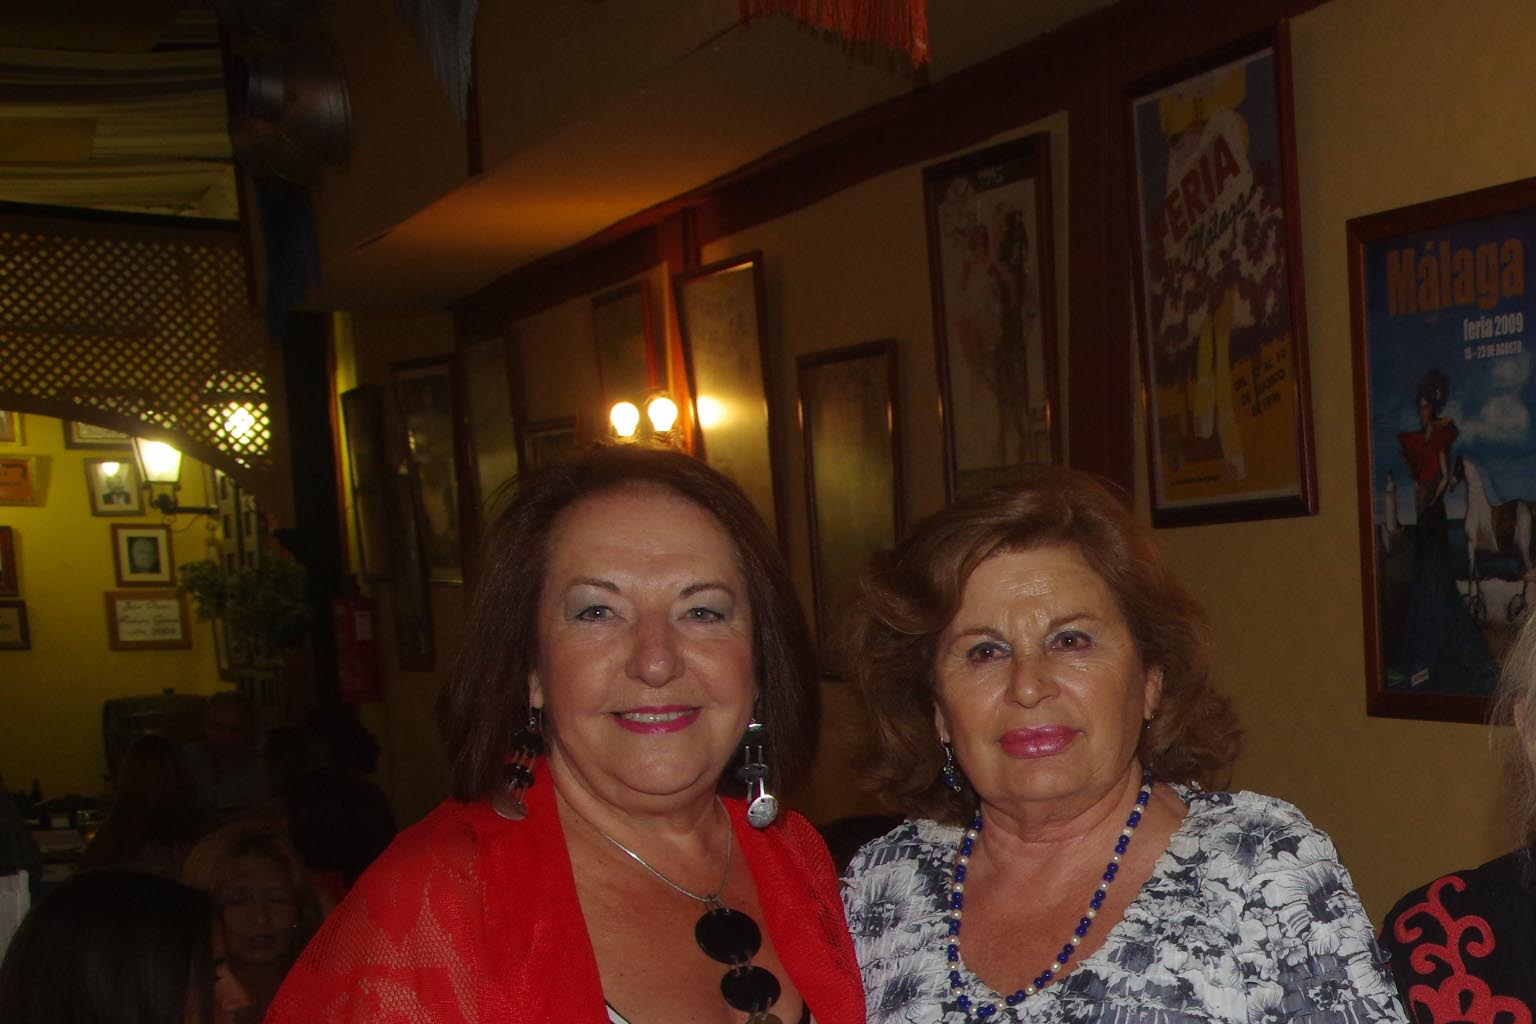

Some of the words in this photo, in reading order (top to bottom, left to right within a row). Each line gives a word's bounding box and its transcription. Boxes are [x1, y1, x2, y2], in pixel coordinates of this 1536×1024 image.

[1386, 238, 1526, 319] Málaga
[1463, 315, 1494, 342] feria
[1495, 311, 1524, 338] 2009
